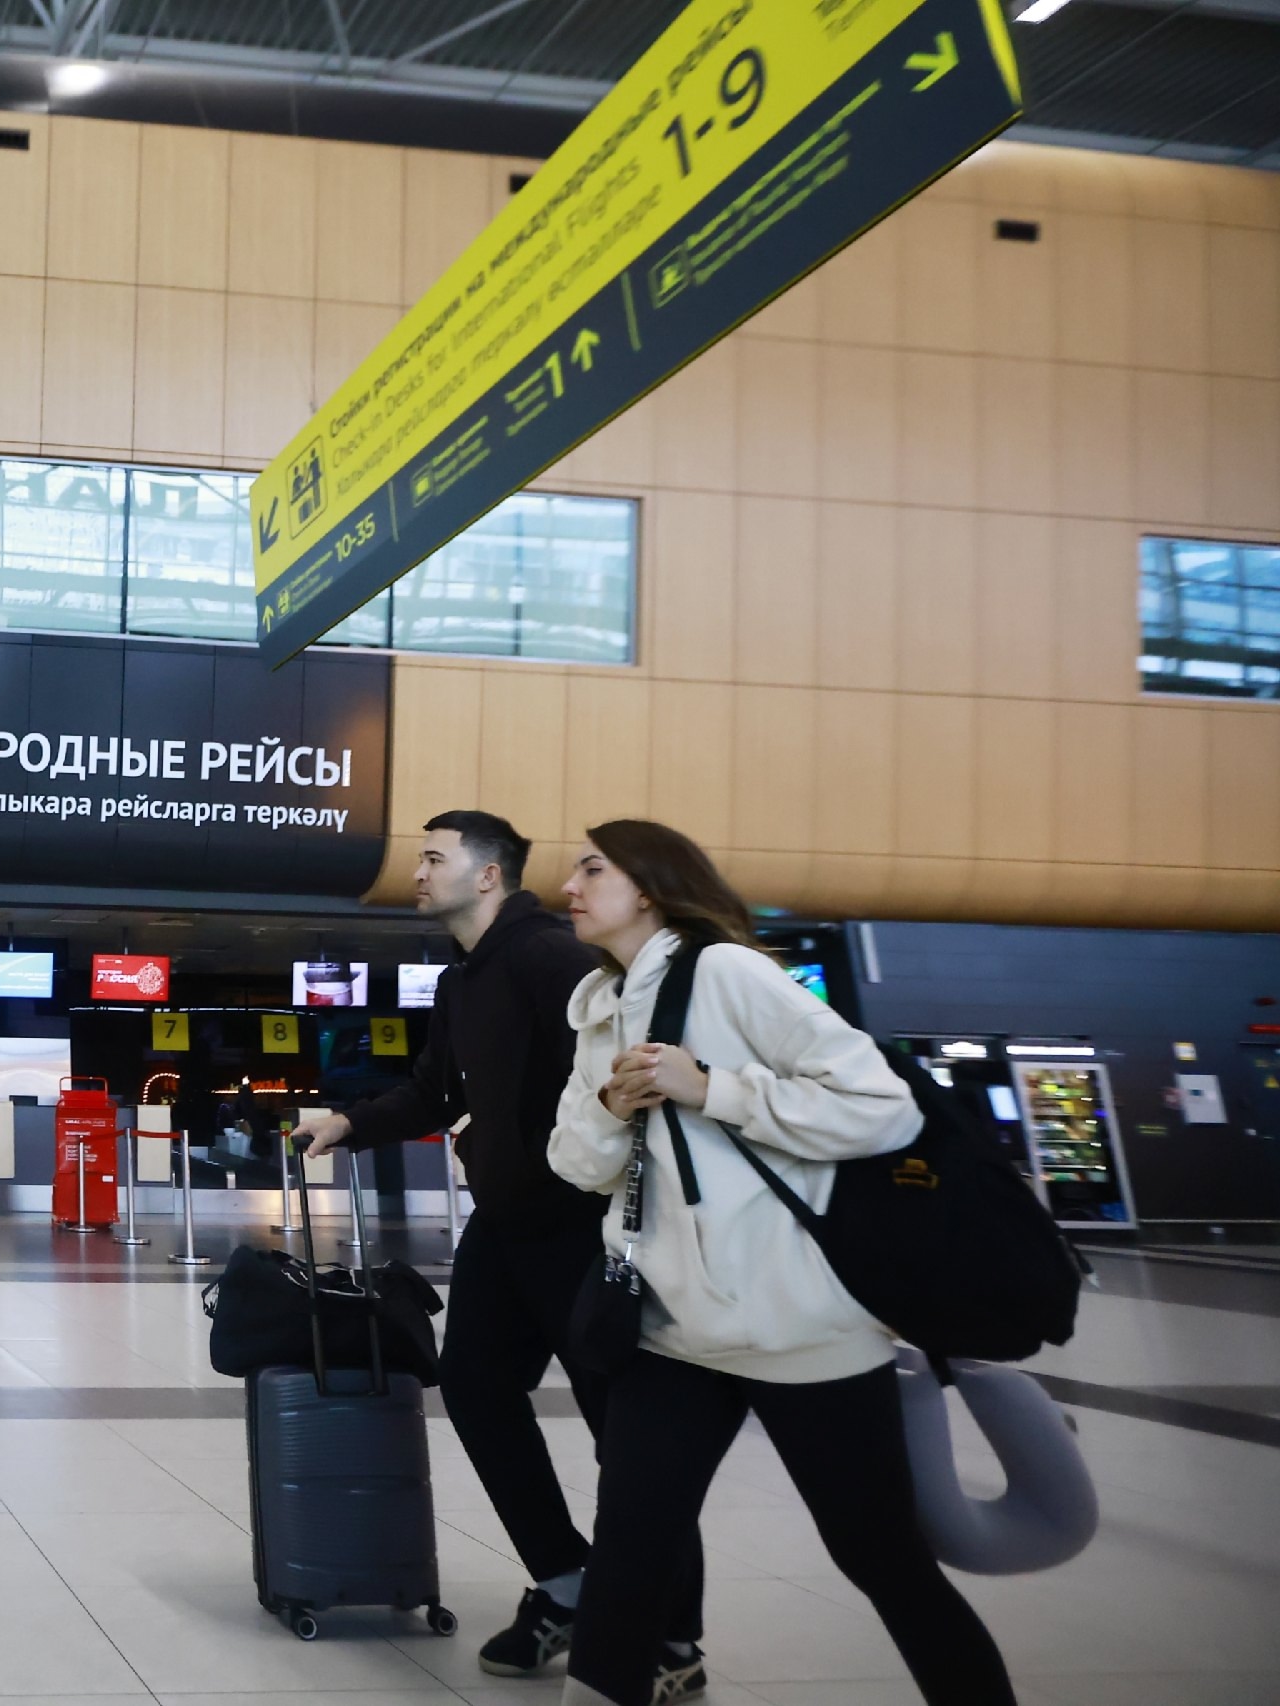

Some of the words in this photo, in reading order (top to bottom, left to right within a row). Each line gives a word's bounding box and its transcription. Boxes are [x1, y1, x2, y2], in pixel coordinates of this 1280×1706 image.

[662, 45, 767, 180] 1-9
[330, 389, 371, 438] Стойки
[373, 295, 462, 398] регистрации
[465, 269, 486, 298] на
[489, 88, 661, 273] международные
[332, 411, 383, 468] Check-in
[385, 369, 425, 418] Desks
[450, 229, 563, 352] International
[334, 512, 376, 562] 10-35
[200, 735, 352, 787] РЕЙСЫ
[100, 791, 236, 826] рейсларга
[243, 803, 349, 833] теркәлү
[163, 1019, 177, 1039] 7
[273, 1022, 287, 1041] 8
[381, 1024, 396, 1044] 9
